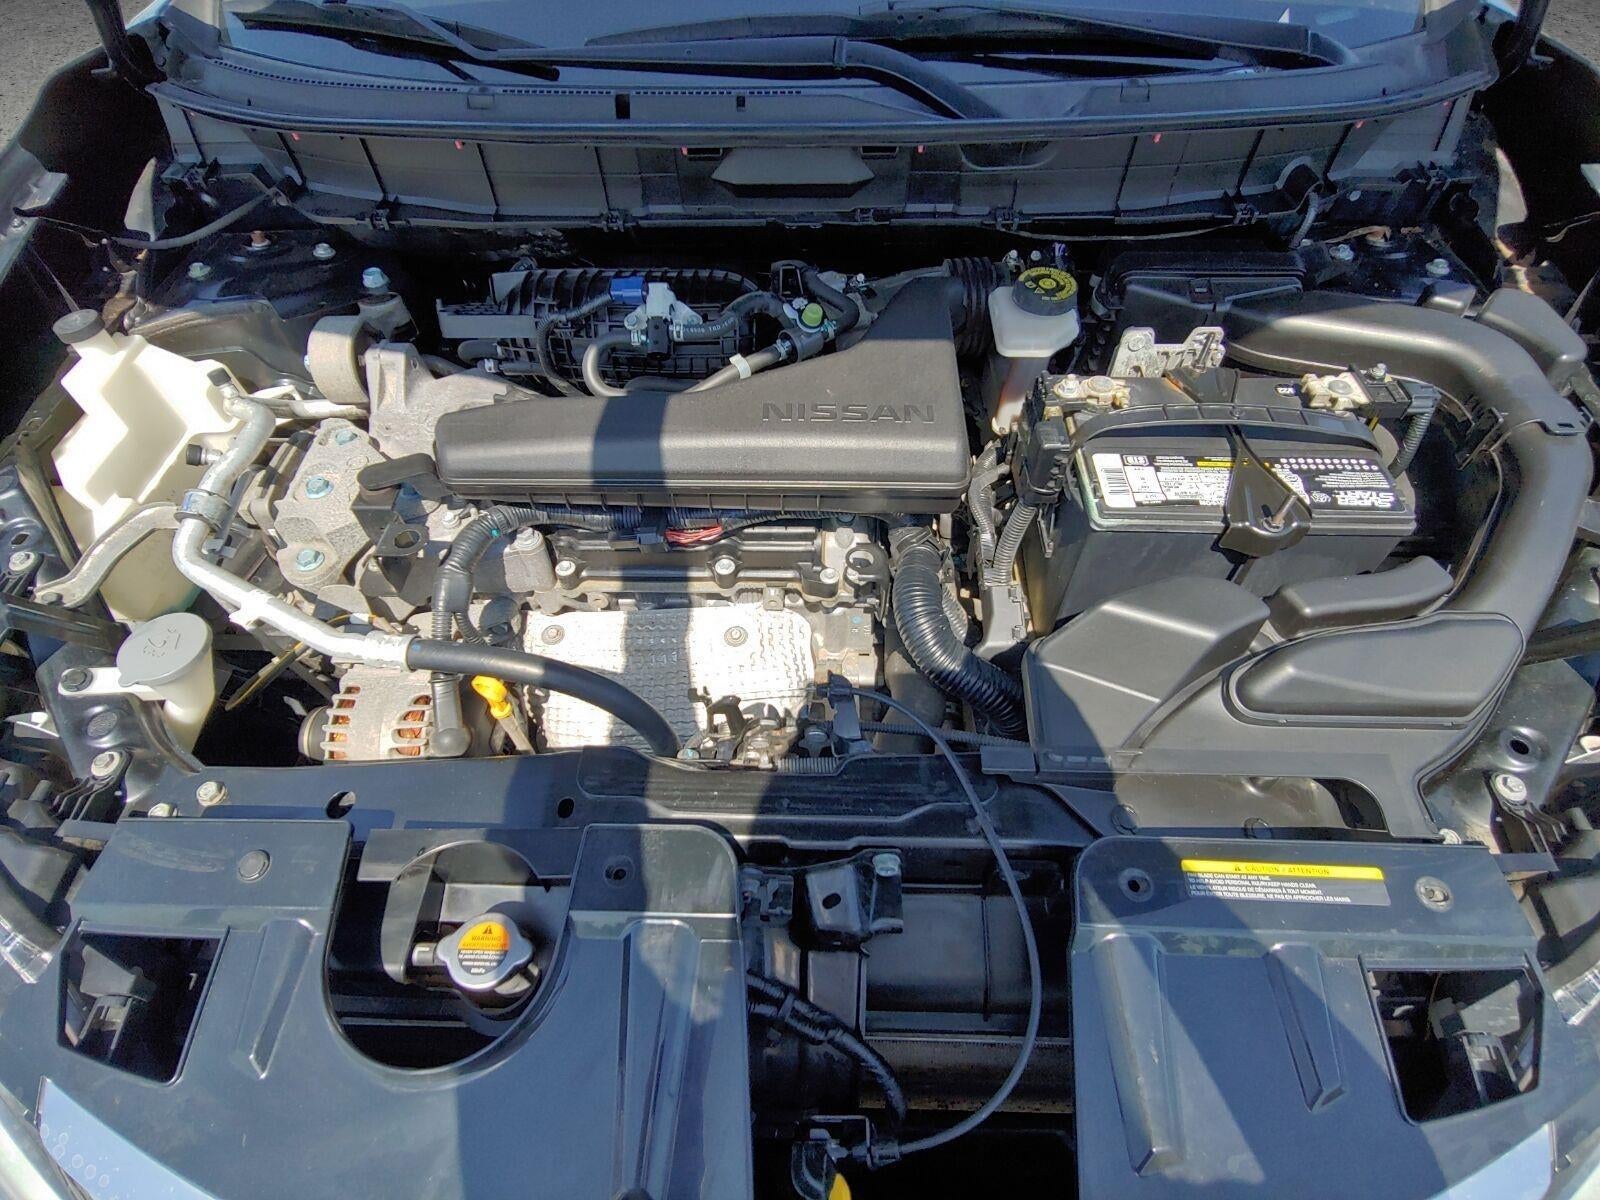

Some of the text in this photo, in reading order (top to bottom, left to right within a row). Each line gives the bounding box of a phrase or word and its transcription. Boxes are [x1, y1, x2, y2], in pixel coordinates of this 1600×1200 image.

[762, 402, 935, 423] NISSAN
[1337, 490, 1395, 501] START
[1338, 496, 1391, 508] SUPER
[1245, 865, 1280, 873] CAUTION
[1288, 867, 1330, 875] ATTENTION
[1293, 894, 1324, 902] APPROCHER
